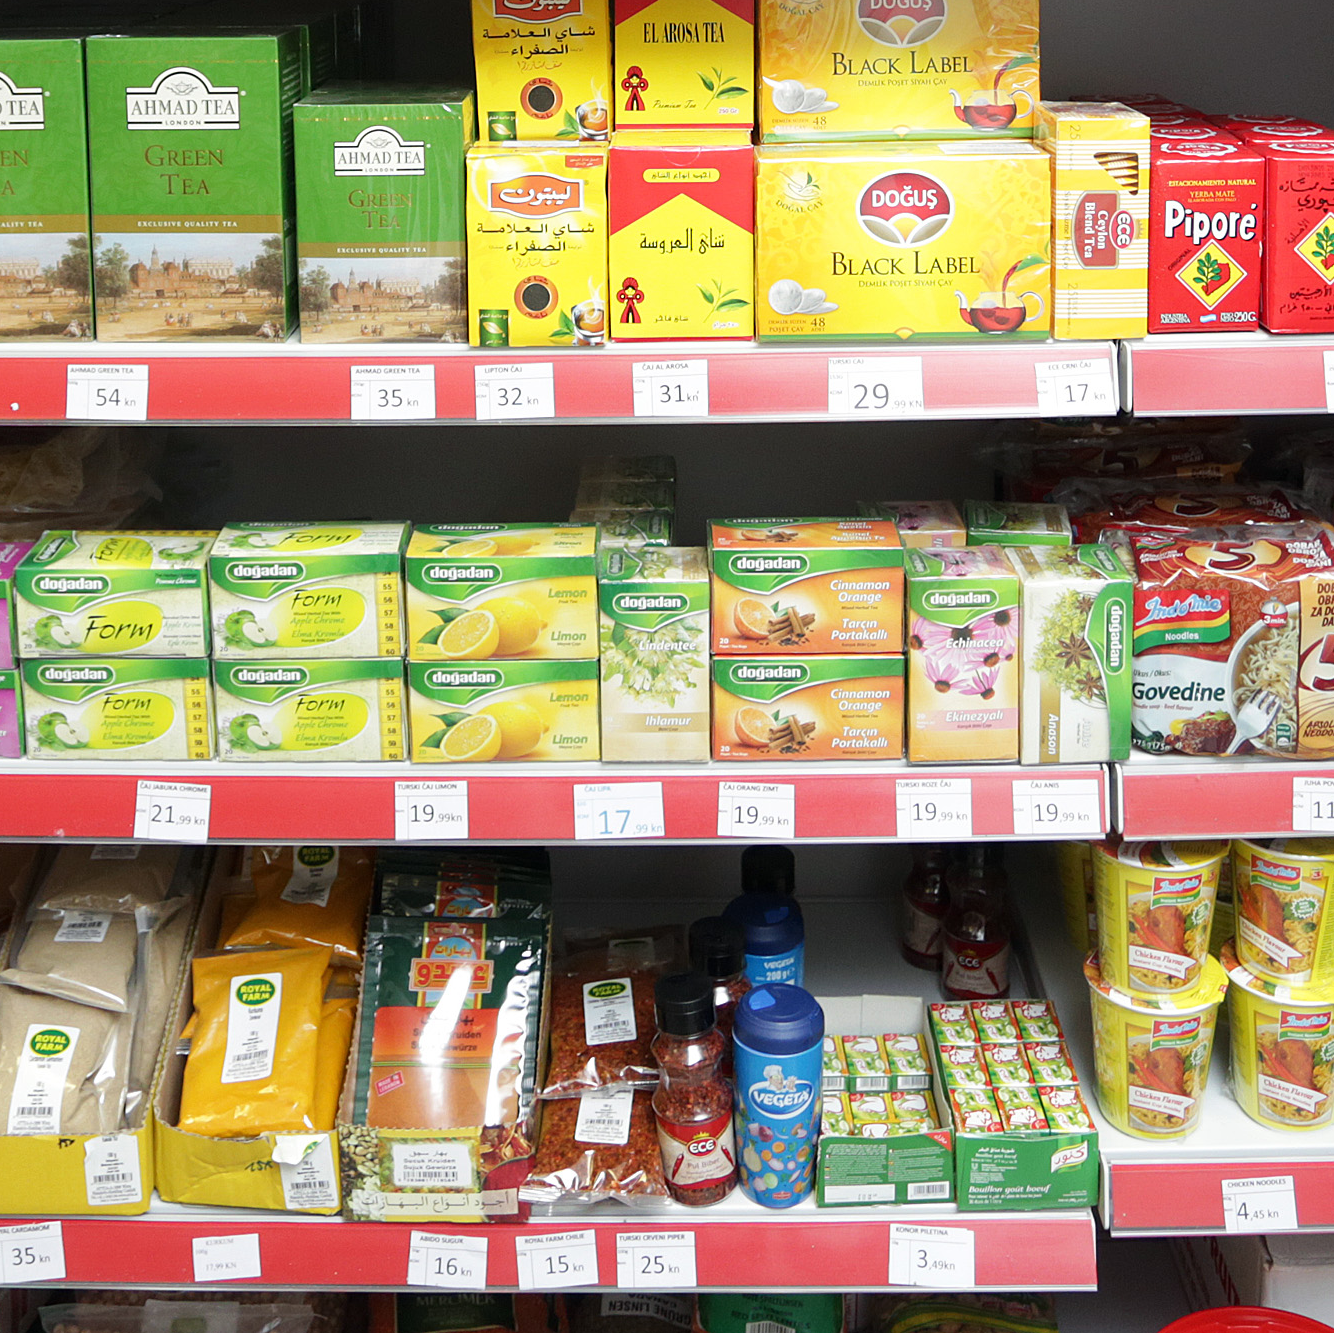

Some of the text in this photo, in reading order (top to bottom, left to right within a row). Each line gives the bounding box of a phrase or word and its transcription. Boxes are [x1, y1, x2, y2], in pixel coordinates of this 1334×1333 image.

[643, 22, 725, 44] EL AROSA TEA
[832, 51, 973, 76] BLACK LABEL
[131, 99, 236, 117] AHMAD TEA
[872, 184, 938, 210] DOĞUŞ
[1164, 201, 1257, 244] Piporé
[95, 389, 136, 406] 54 kn
[497, 387, 539, 407] 32 kn
[737, 555, 800, 572] doğadan
[430, 566, 494, 582] doğadan
[830, 580, 890, 591] Cinnamon
[549, 588, 587, 599] Lemon
[838, 592, 881, 603] Orange
[84, 615, 153, 644] Form
[842, 618, 877, 630] Tarçın
[551, 631, 586, 642] Limon
[831, 629, 888, 641] Portakallı
[1165, 630, 1199, 641] Noodles
[639, 640, 696, 653] Lindentee
[946, 637, 1004, 649] Echinacea
[1133, 683, 1225, 702] Govedine
[645, 715, 691, 727] Ihlamur
[945, 710, 1003, 723] Ekinezyalı
[34, 1034, 67, 1042] ROYAL
[35, 1042, 64, 1051] FARM
[753, 1089, 811, 1107] VEGETA
[969, 1185, 1003, 1194] Bouillon
[641, 1256, 680, 1275] 25 kn
